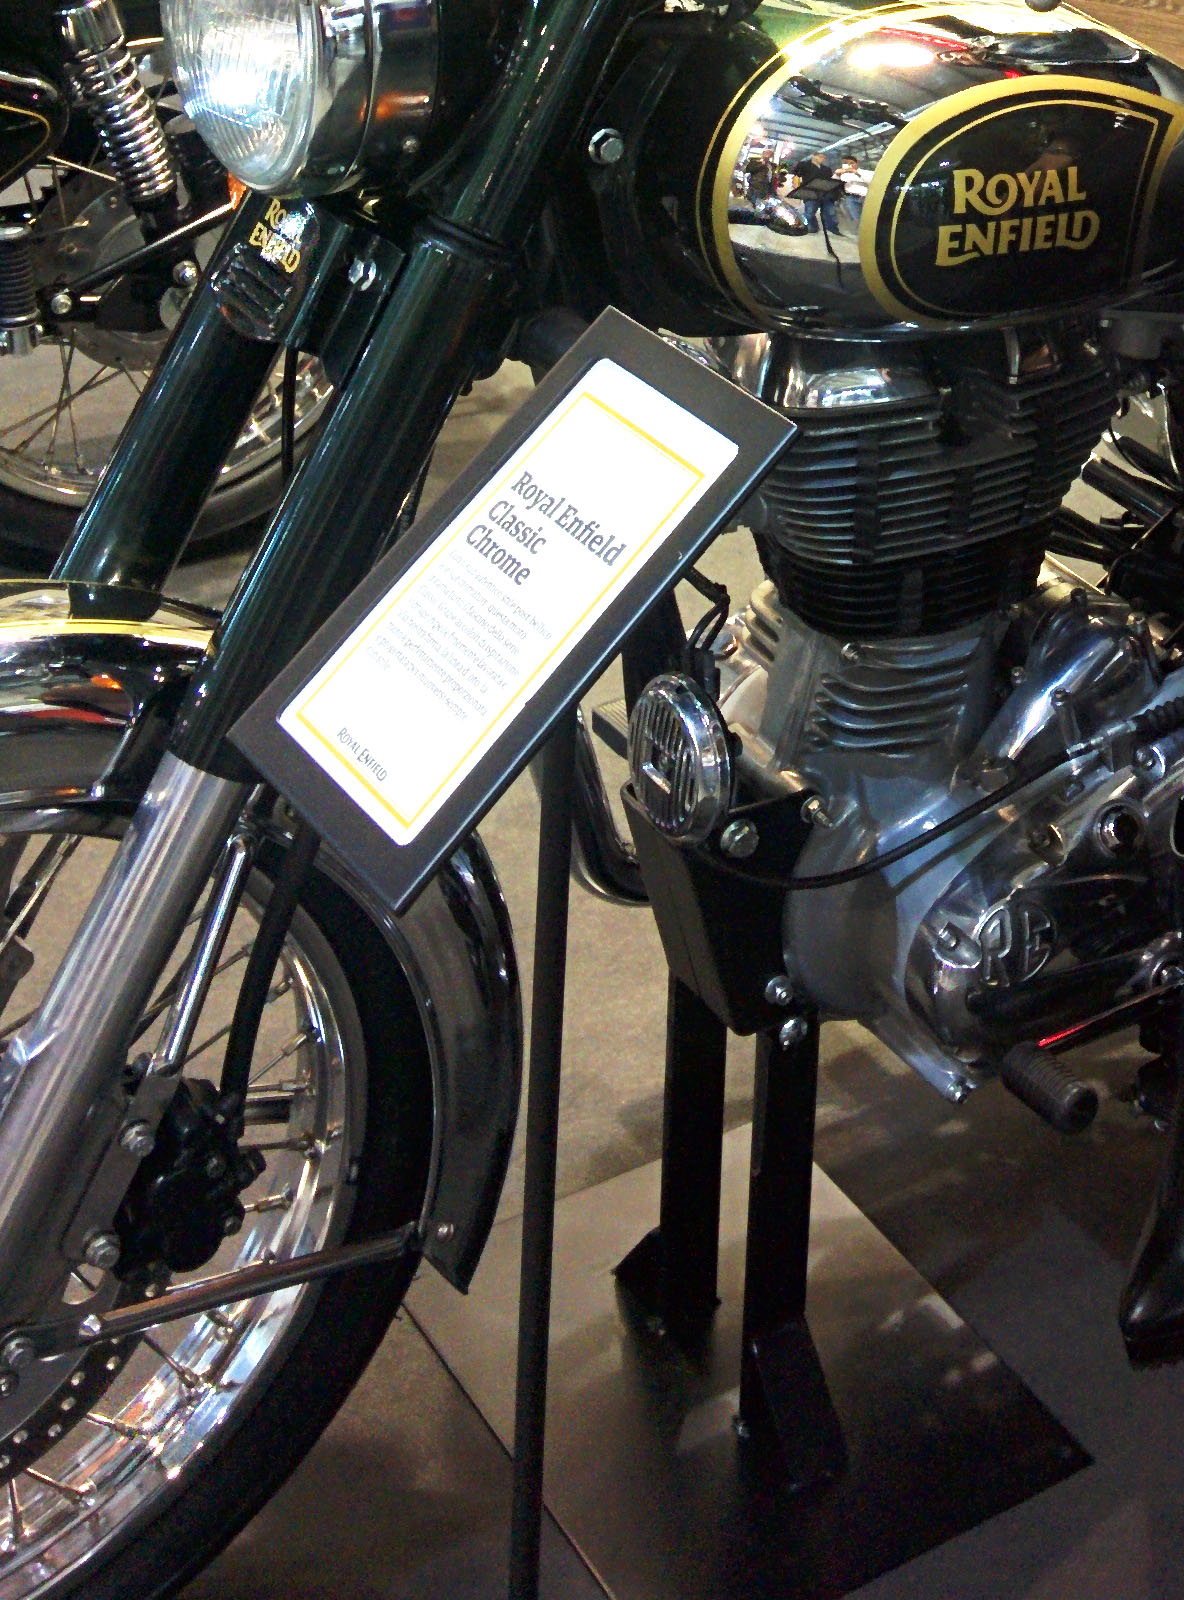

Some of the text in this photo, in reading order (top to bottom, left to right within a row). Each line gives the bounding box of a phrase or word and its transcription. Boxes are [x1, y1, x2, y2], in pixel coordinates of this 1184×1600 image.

[952, 166, 1087, 216] ROYAL
[935, 209, 1100, 267] ENFIELD
[488, 500, 547, 555] Classic
[510, 470, 627, 567] Royal Enfield
[465, 524, 531, 586] Chrome
[336, 727, 388, 782] ROYAL ENFIELD
